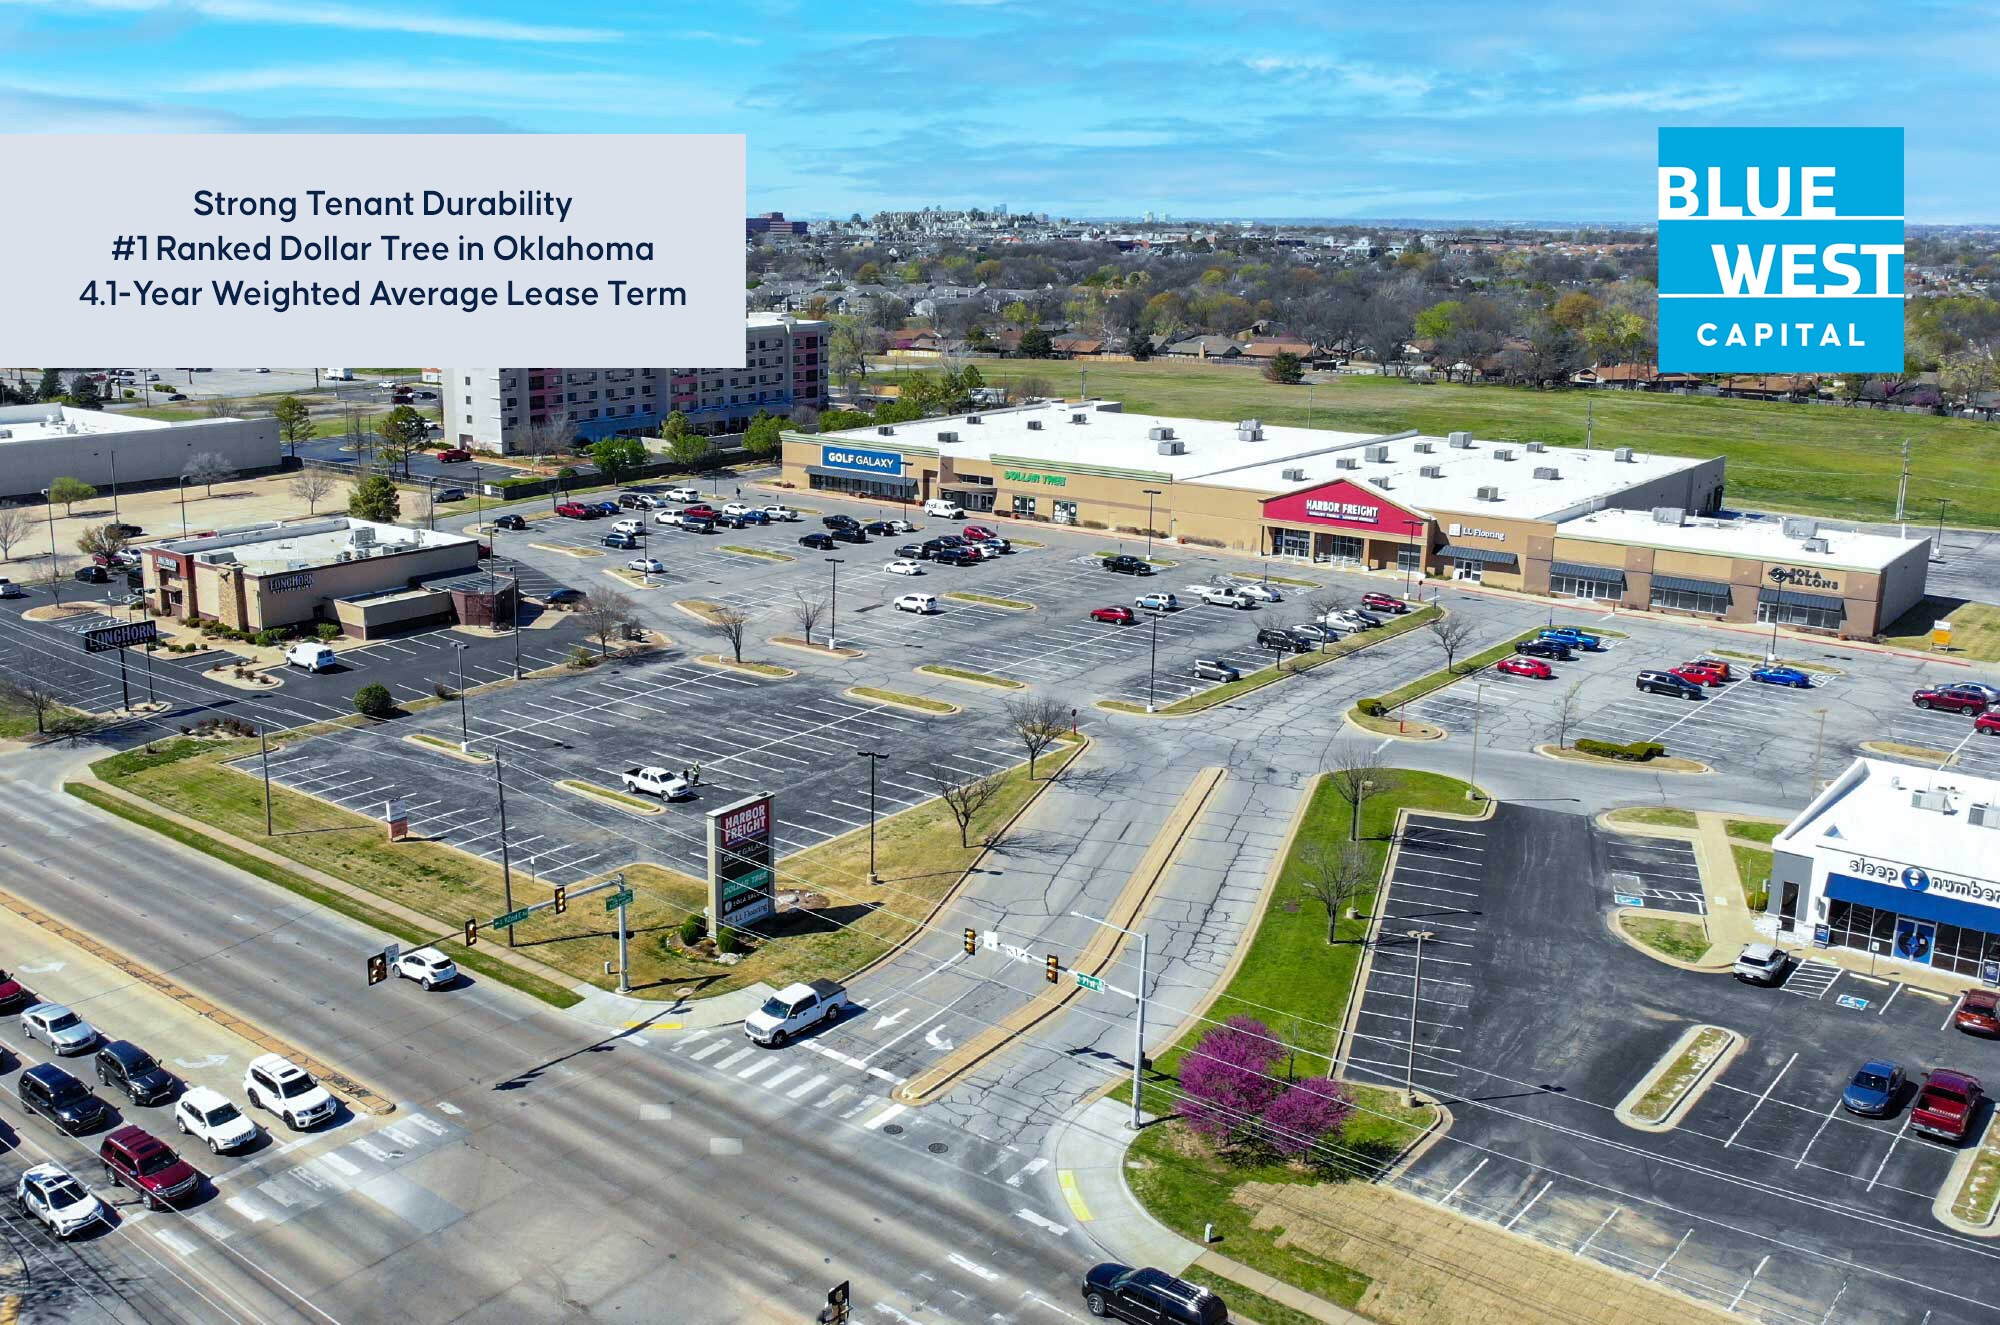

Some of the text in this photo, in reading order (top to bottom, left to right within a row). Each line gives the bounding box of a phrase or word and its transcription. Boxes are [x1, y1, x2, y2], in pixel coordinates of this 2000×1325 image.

[828, 452, 894, 468] GOLF GALAXY
[1306, 500, 1340, 513] HARBOR
[1342, 504, 1379, 517] FREIGHT
[1463, 527, 1505, 541] LL Flooring
[725, 804, 766, 830] HARBOR
[725, 816, 766, 842] FREIGHT
[1849, 858, 1898, 883] sleep
